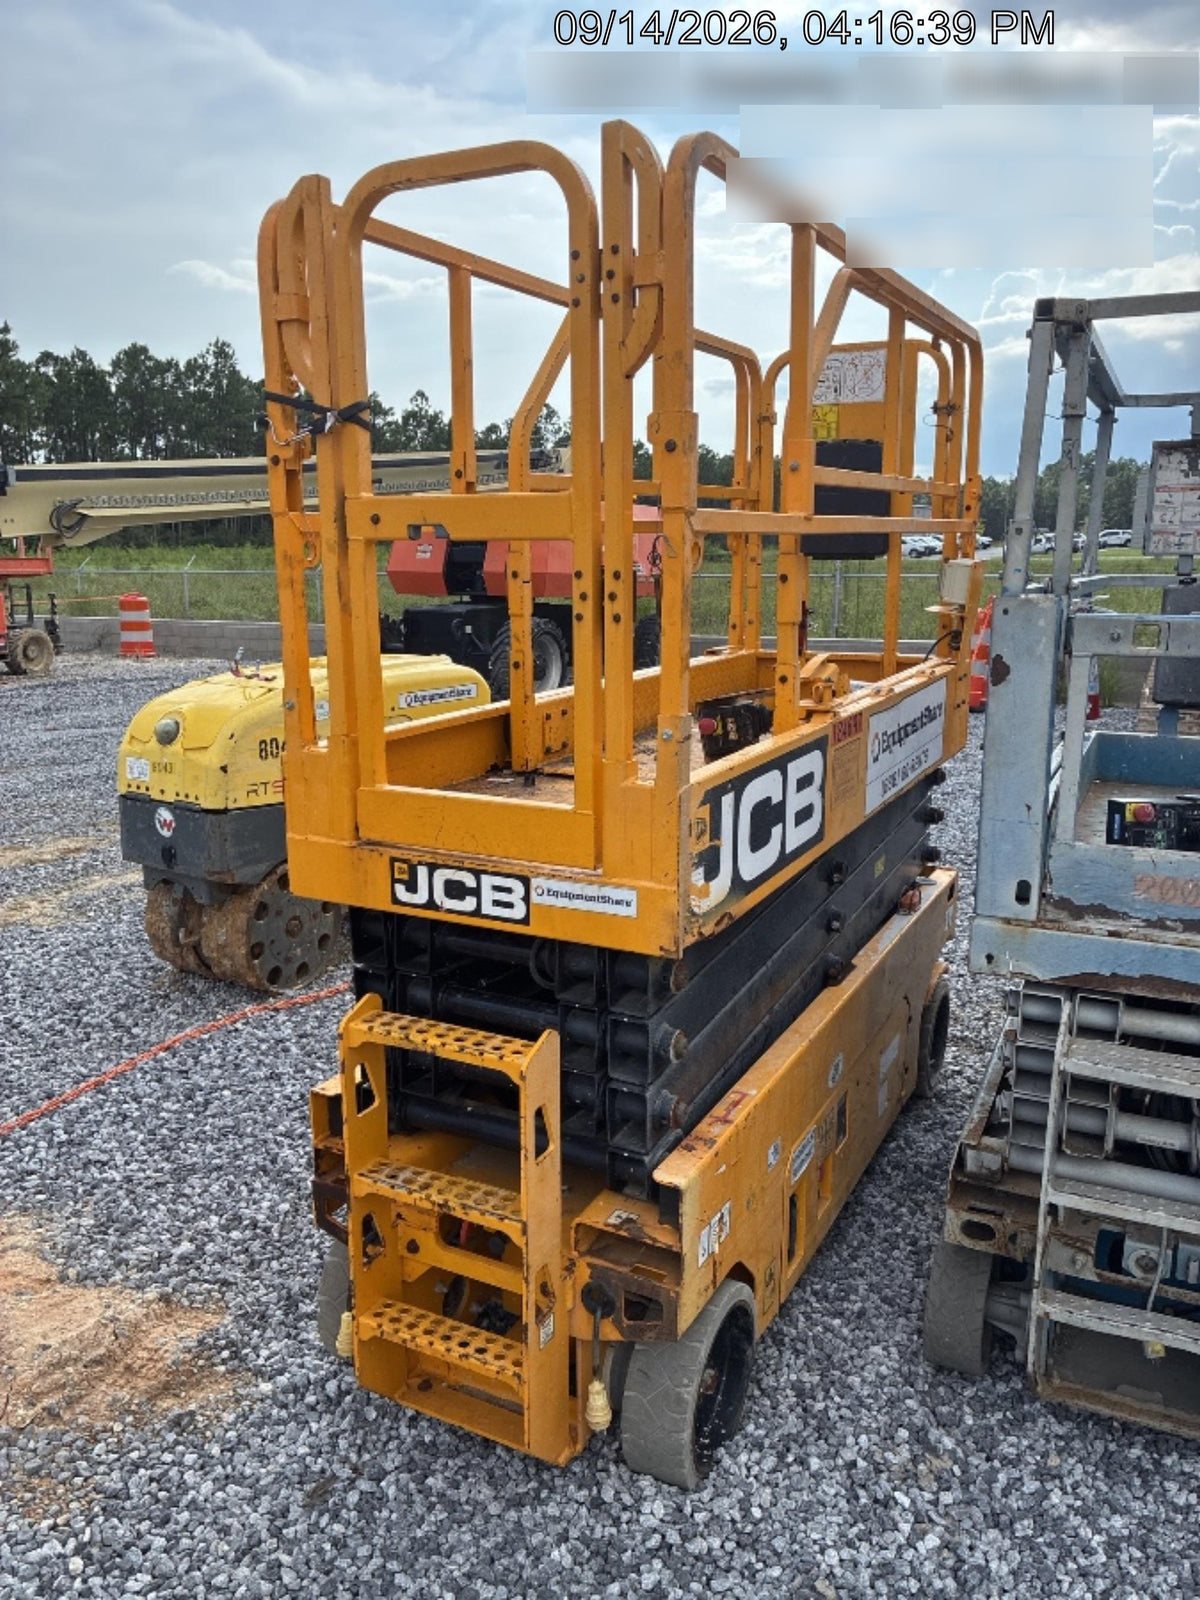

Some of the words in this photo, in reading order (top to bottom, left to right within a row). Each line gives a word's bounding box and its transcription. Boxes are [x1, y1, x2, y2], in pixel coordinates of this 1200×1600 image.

[258, 737, 287, 761] 80
[689, 750, 824, 914] JCB
[393, 864, 527, 920] JCB
